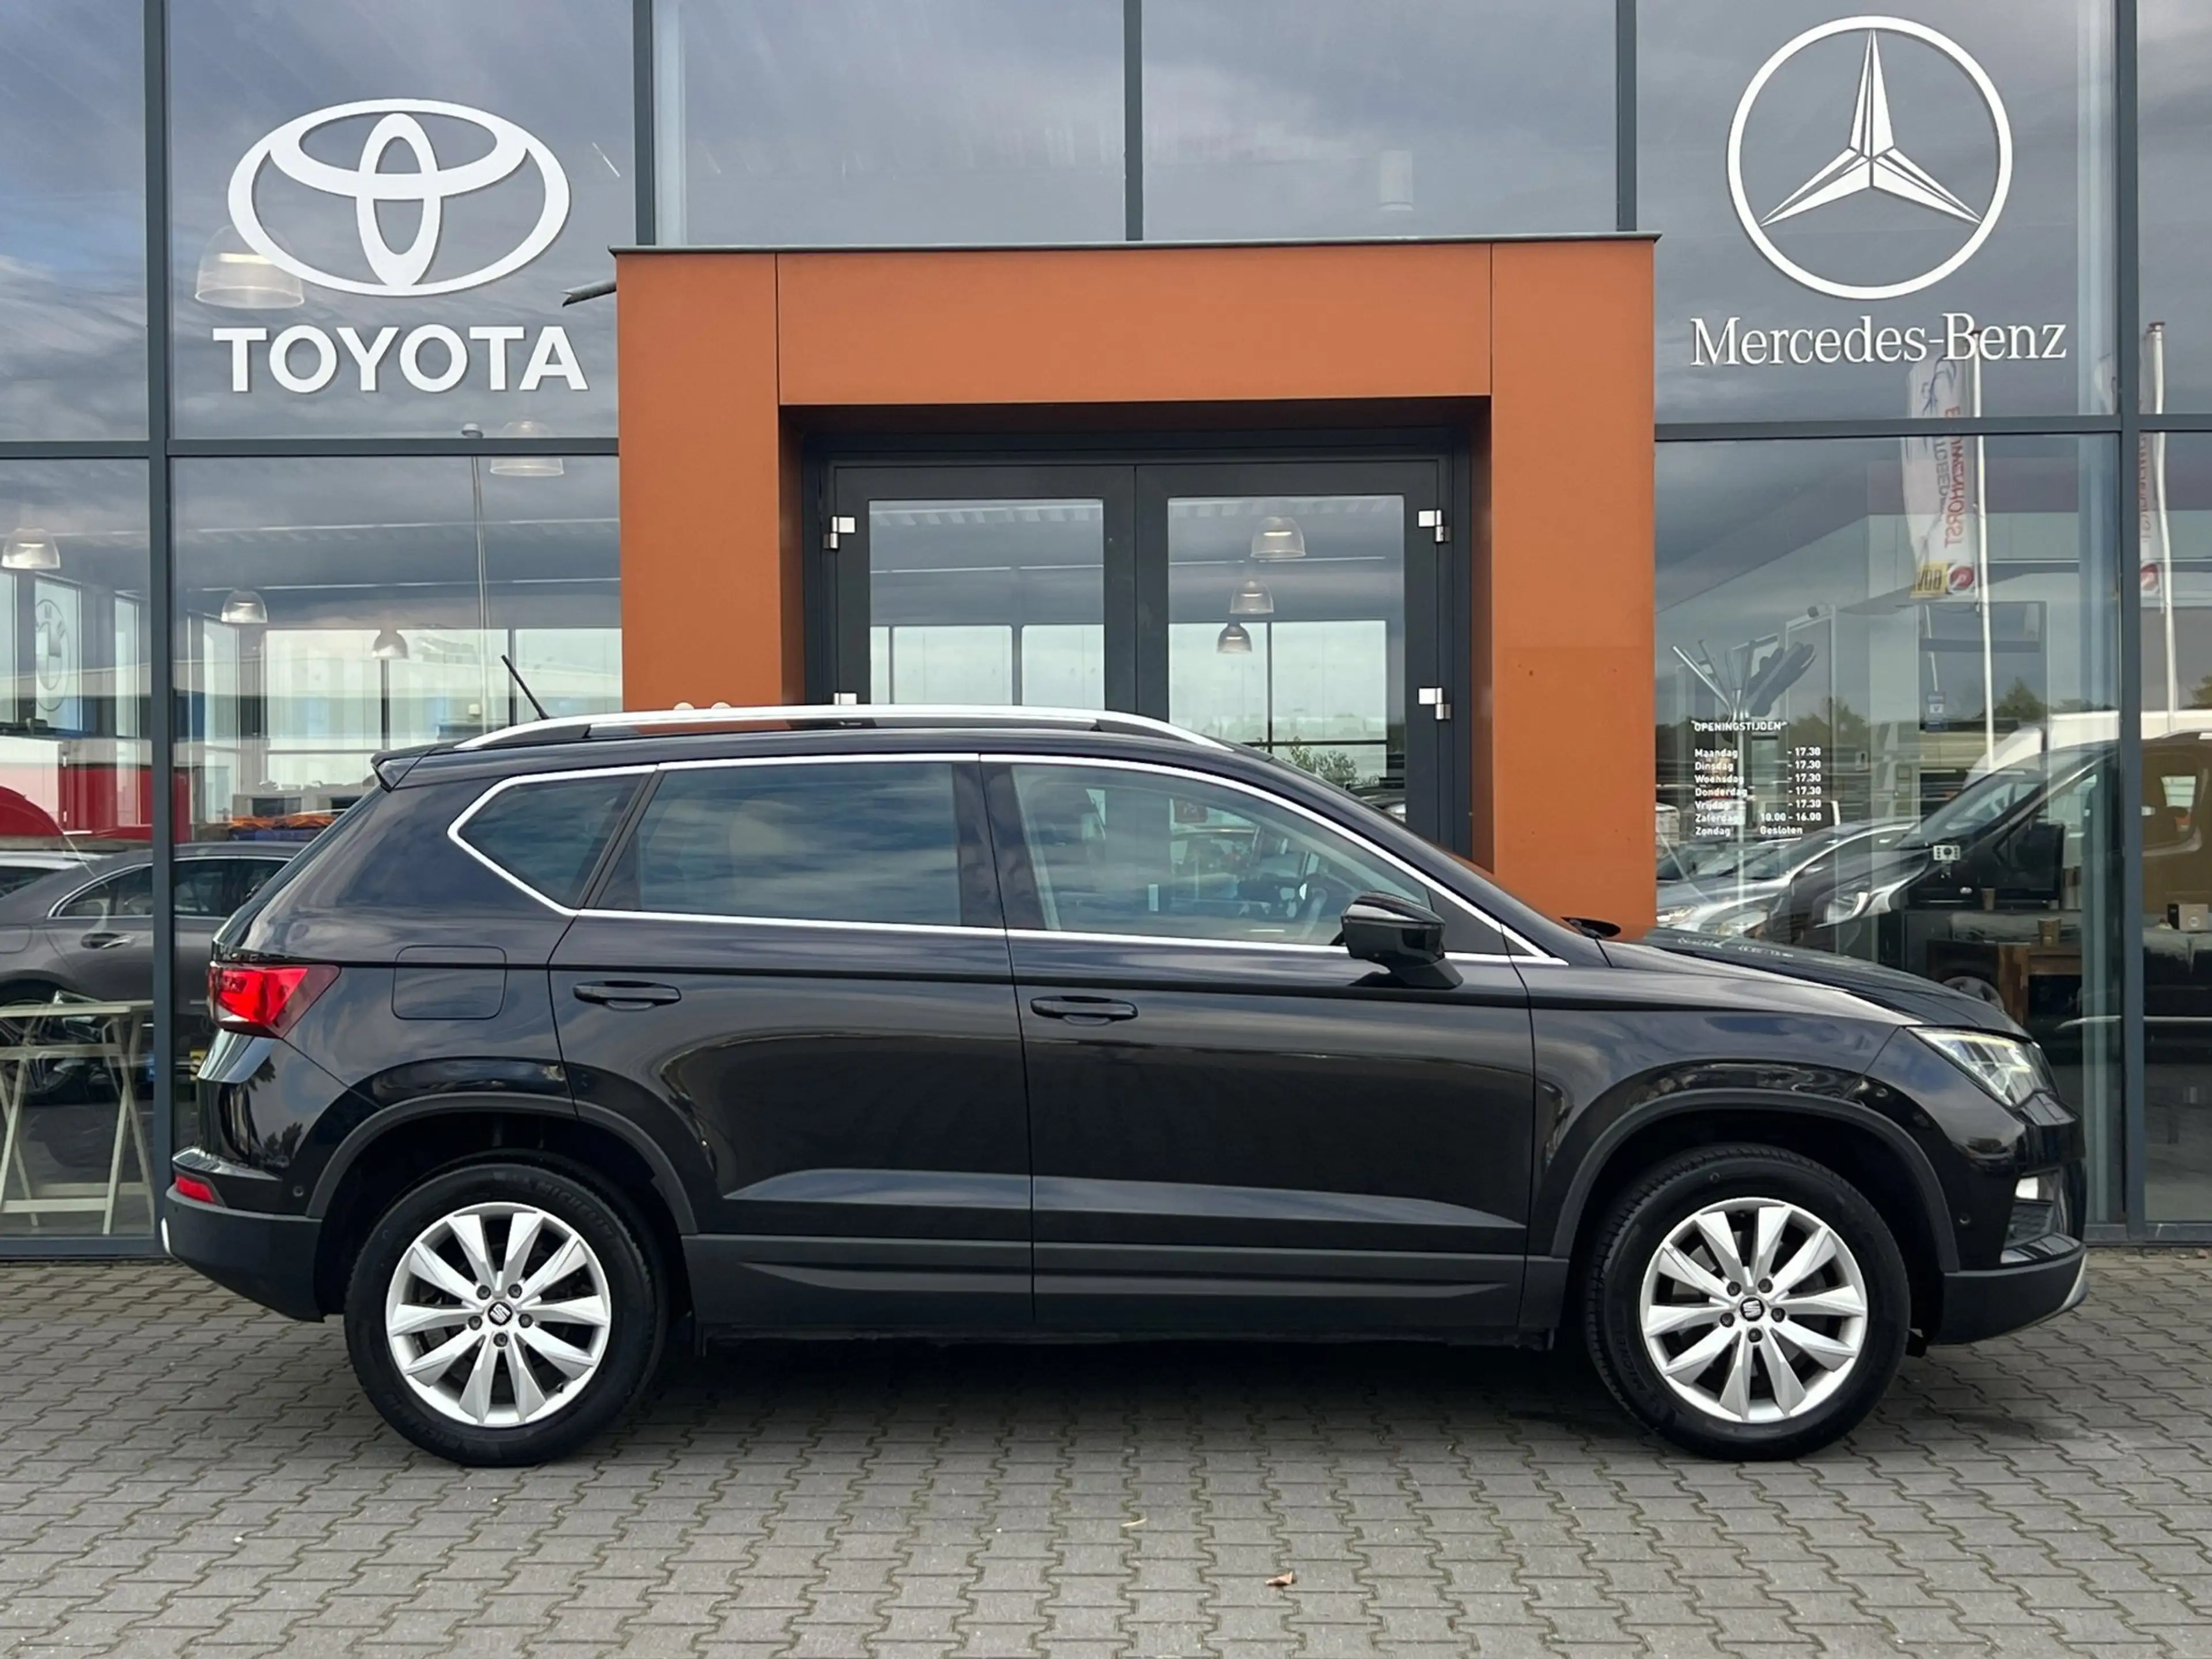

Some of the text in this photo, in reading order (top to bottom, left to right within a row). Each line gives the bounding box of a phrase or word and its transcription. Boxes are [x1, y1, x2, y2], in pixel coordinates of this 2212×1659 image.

[1690, 312, 2067, 366] Mercedes-Benz
[213, 324, 589, 393] TOYOTA
[1694, 748, 1738, 759] Maandag
[1795, 747, 1821, 756] 17.30
[1695, 762, 1734, 772] Dinsdag
[1795, 760, 1821, 770] 17.30
[1795, 773, 1821, 782] 17.30
[1695, 787, 1748, 798] Donderdag
[1796, 786, 1821, 795] 17.30
[1796, 799, 1821, 808] 17.30
[1695, 813, 1740, 824] Zaterda
[1760, 812, 1786, 822] 10.00
[1796, 812, 1821, 821] 16.00
[1695, 825, 1803, 837] Zondag Gesloten
